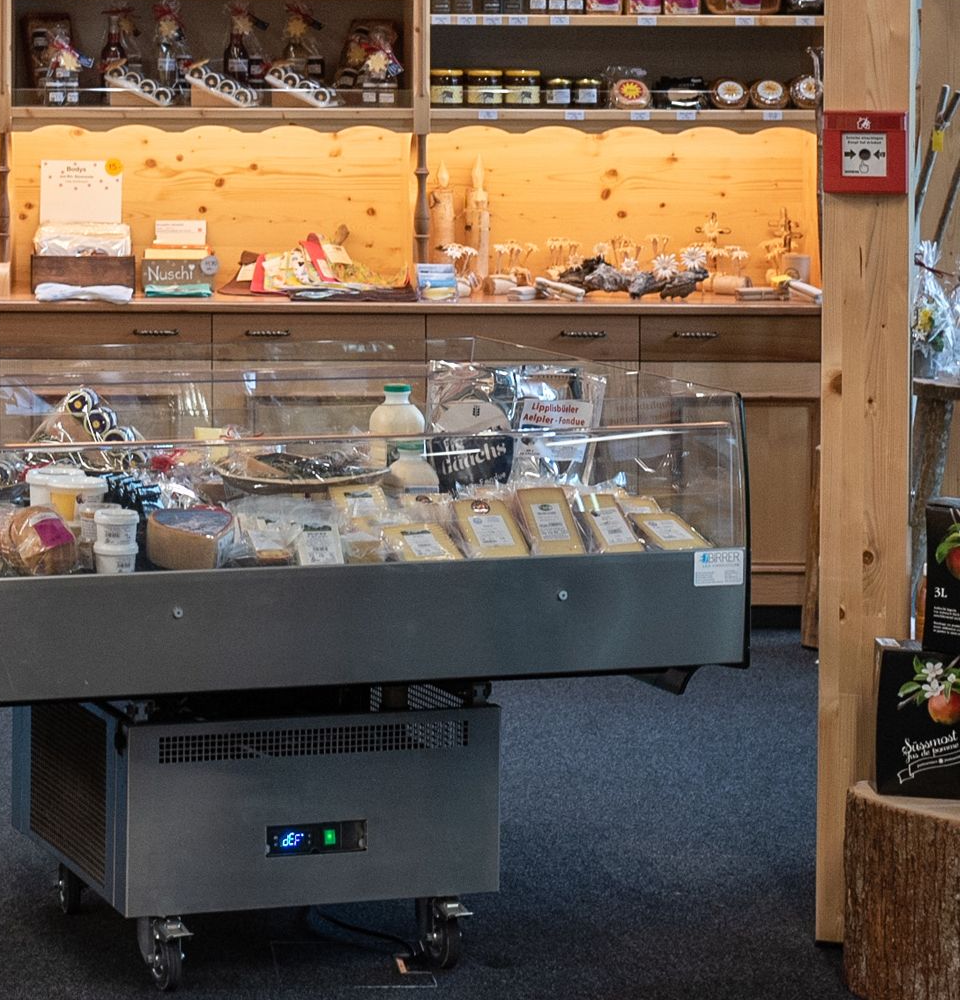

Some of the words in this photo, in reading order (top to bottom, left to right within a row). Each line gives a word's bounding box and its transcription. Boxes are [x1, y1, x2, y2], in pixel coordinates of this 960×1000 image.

[147, 264, 195, 281] Nuschi
[523, 412, 553, 424] Aelpler
[901, 729, 958, 756] Süssmost
